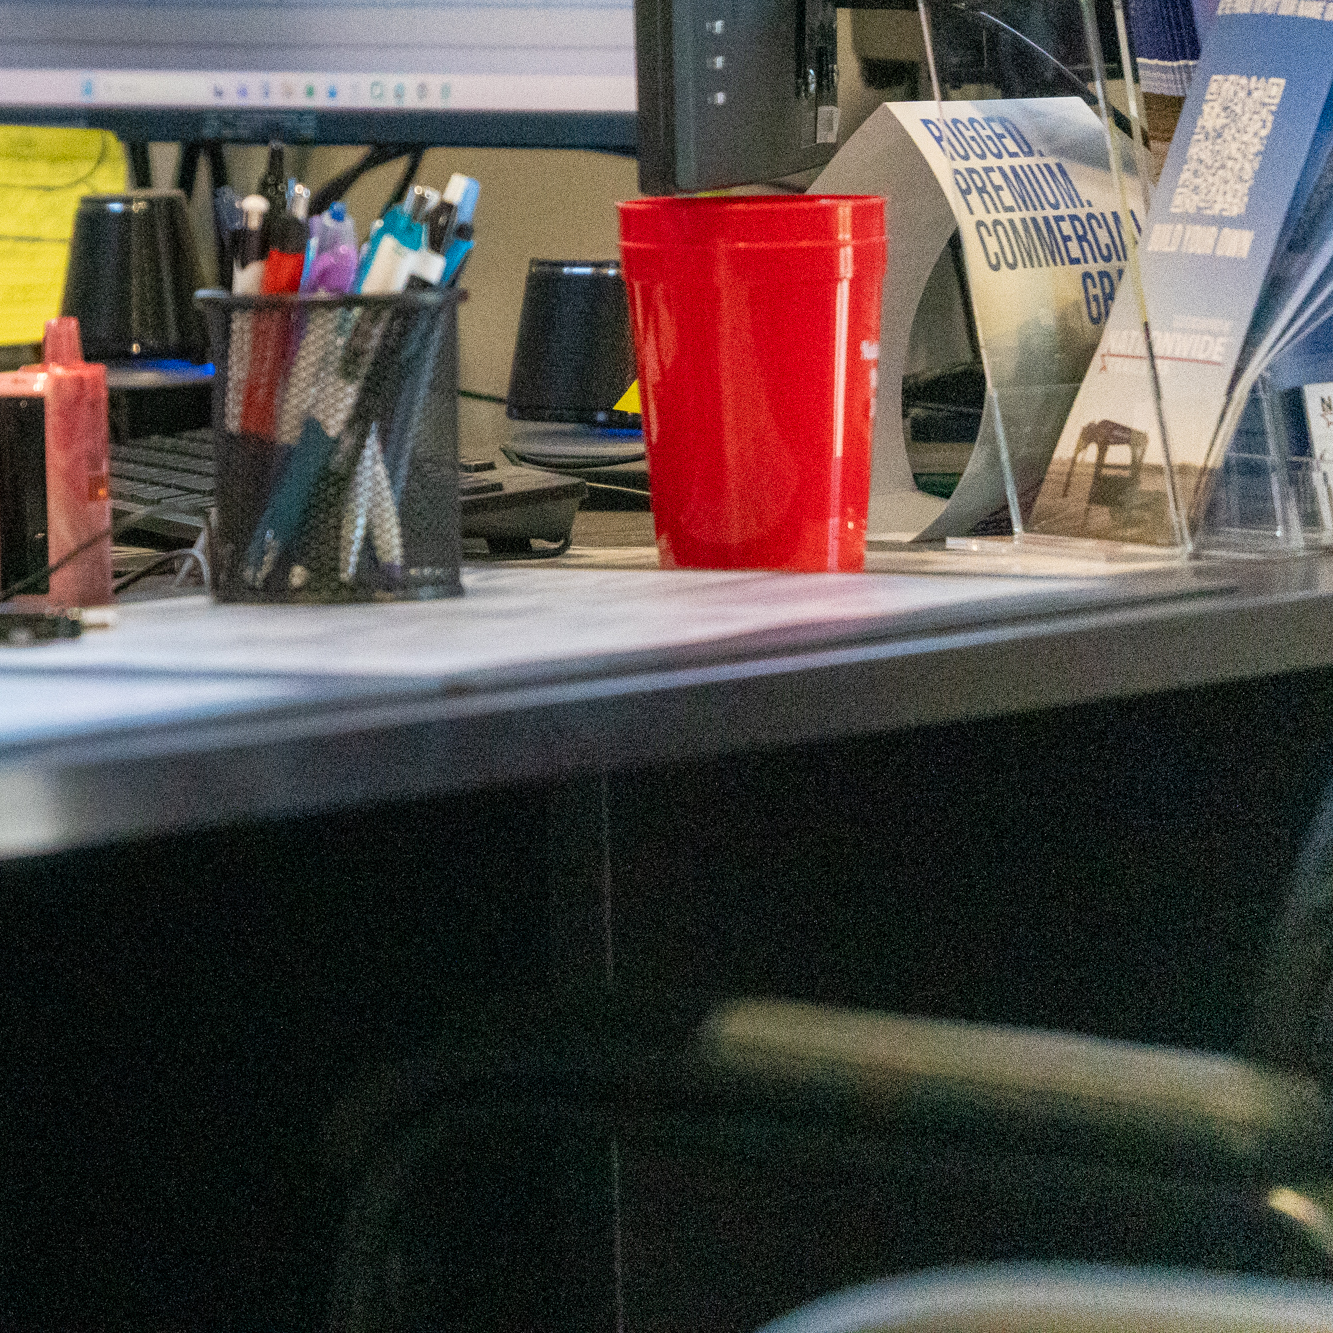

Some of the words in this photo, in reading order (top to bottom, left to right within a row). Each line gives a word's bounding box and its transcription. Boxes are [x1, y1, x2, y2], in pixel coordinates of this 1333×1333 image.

[920, 116, 1045, 162] RUGGED.
[952, 162, 1093, 216] PREMIUM.
[1082, 269, 1124, 325] GR
